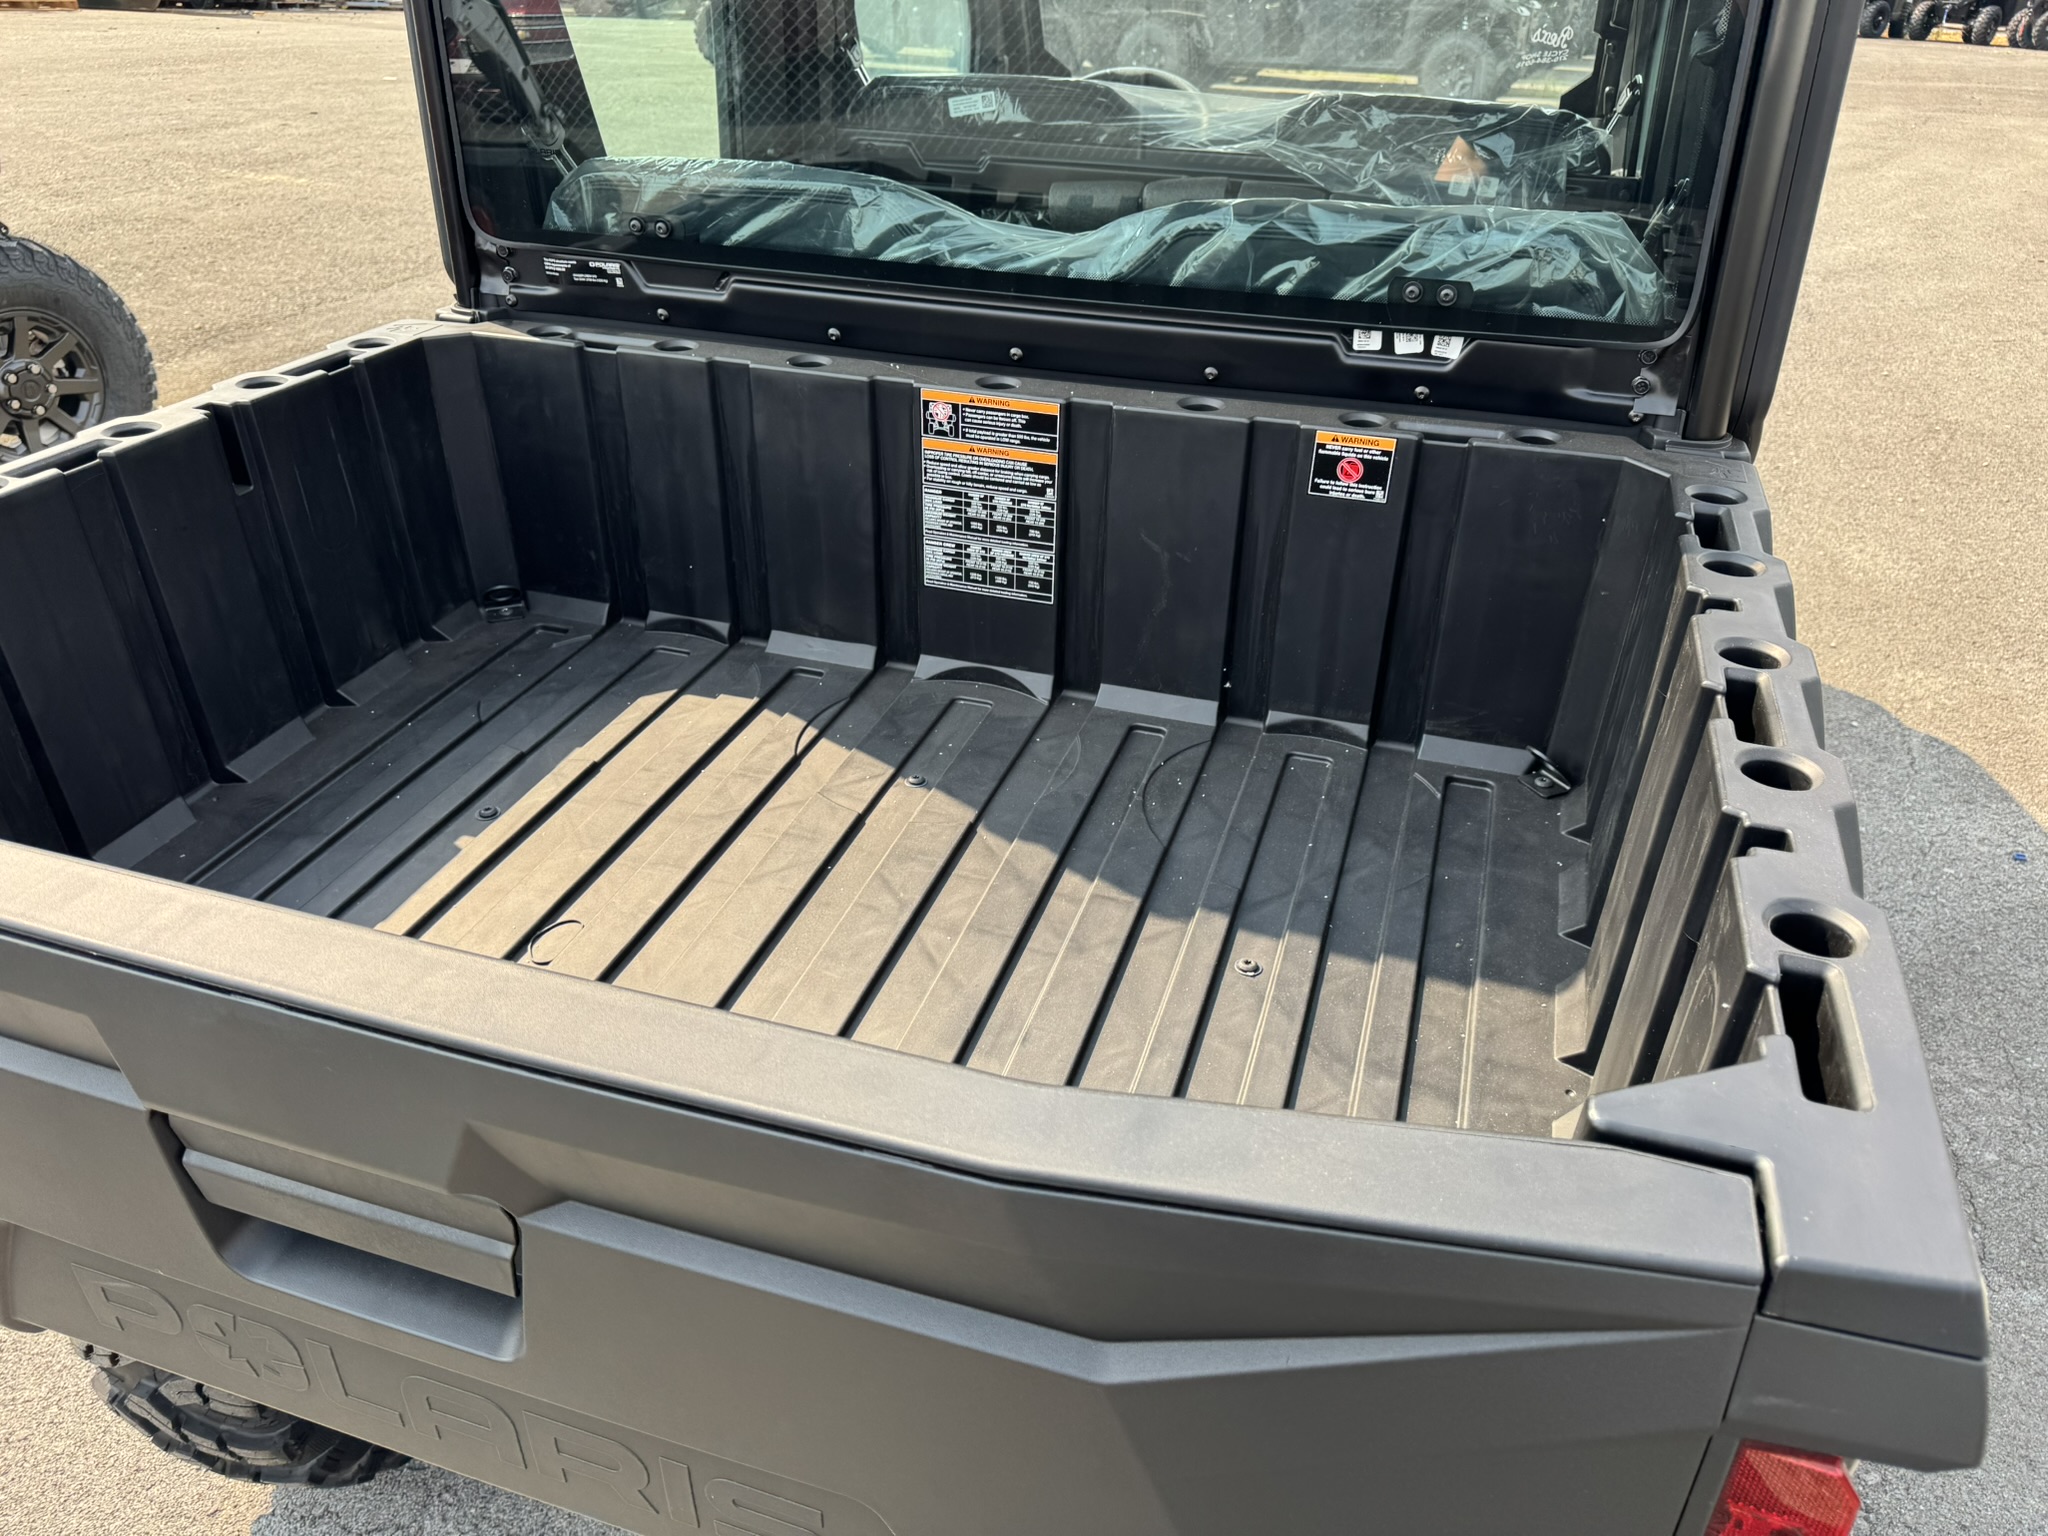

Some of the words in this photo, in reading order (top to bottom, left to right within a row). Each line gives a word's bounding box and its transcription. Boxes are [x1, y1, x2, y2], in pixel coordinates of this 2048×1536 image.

[977, 398, 1010, 407] WARNING
[1341, 436, 1380, 446] WARNING
[977, 447, 1009, 456] WARNING
[71, 1263, 824, 1536] POLARIS
